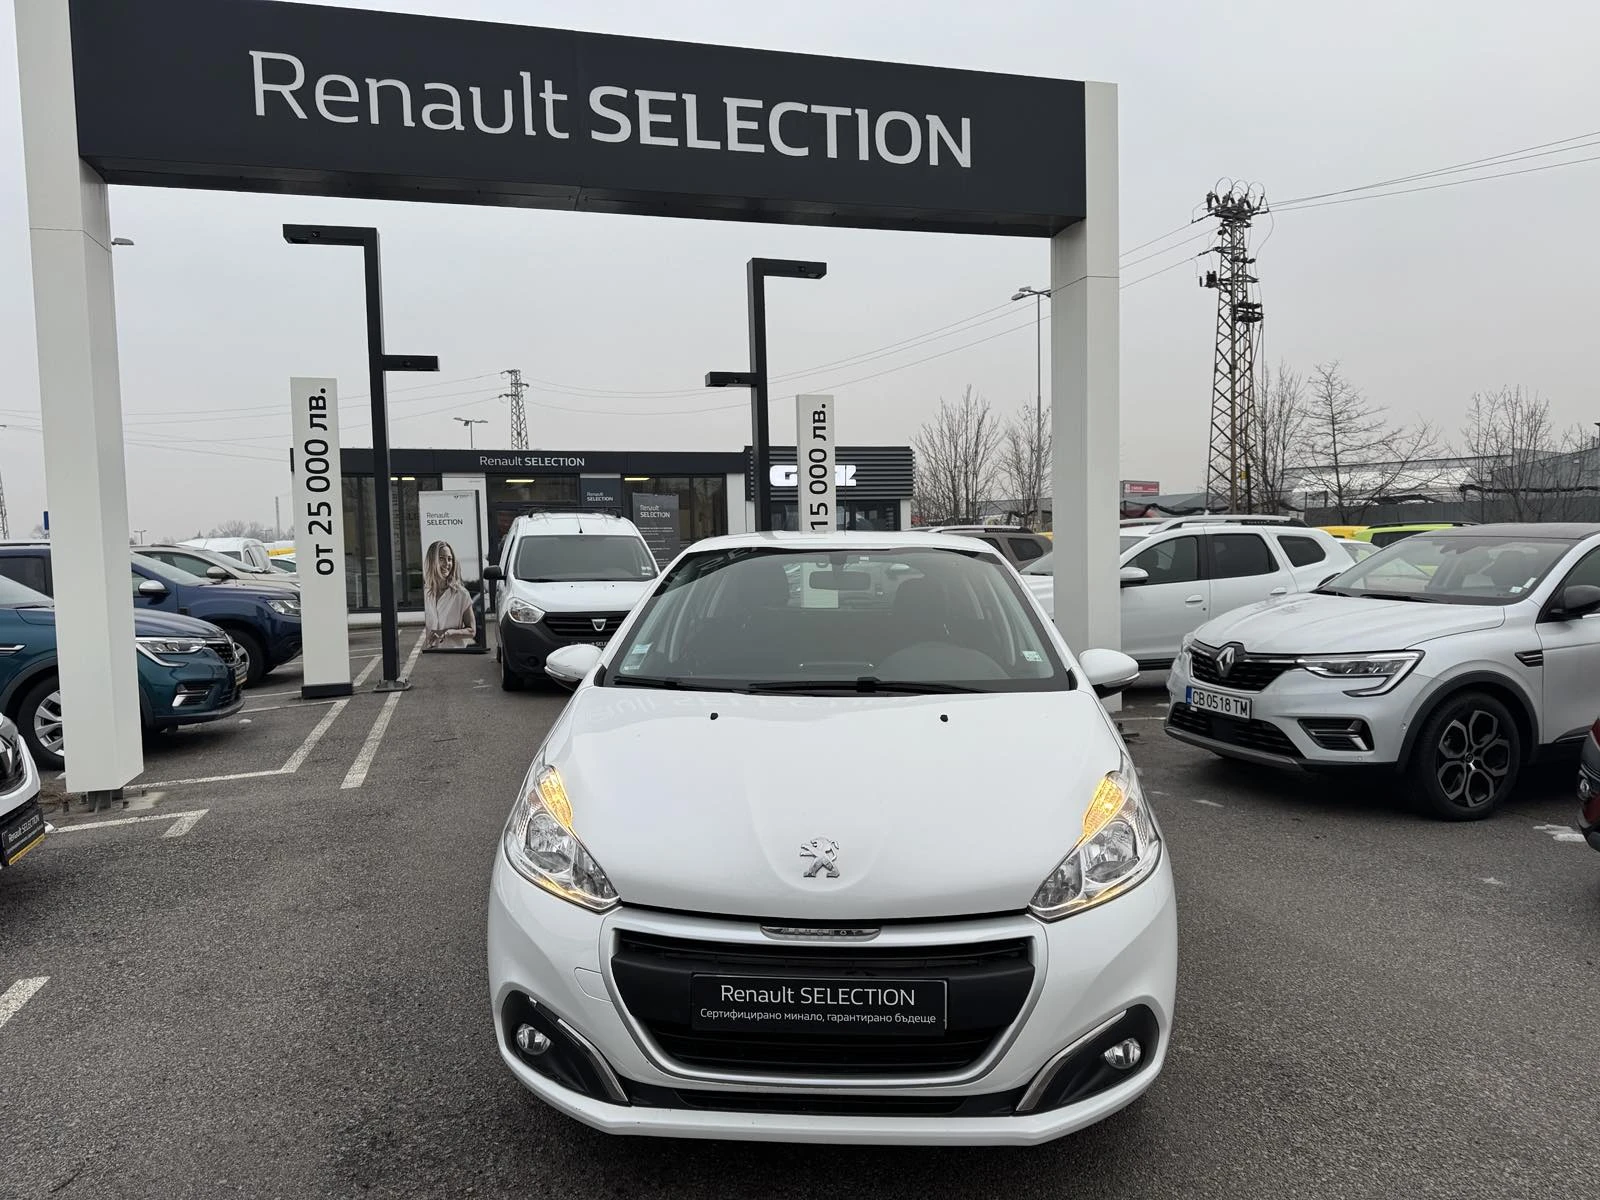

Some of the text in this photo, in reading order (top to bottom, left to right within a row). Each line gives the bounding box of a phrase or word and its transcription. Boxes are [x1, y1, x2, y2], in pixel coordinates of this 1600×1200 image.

[248, 50, 972, 169] Renault SELECTION
[479, 455, 585, 468] Renault SELECTION
[807, 403, 829, 531] 15 000 лв.
[303, 387, 335, 576] от 25 000 лв.
[426, 511, 450, 520] Renault
[639, 504, 661, 512] Renault
[426, 518, 464, 526] SELECTION
[1206, 694, 1231, 712] 0518
[720, 984, 916, 1006] Renault SELECTION
[699, 1007, 937, 1025] Сертифицирано минало, гарантирано бъдеще
